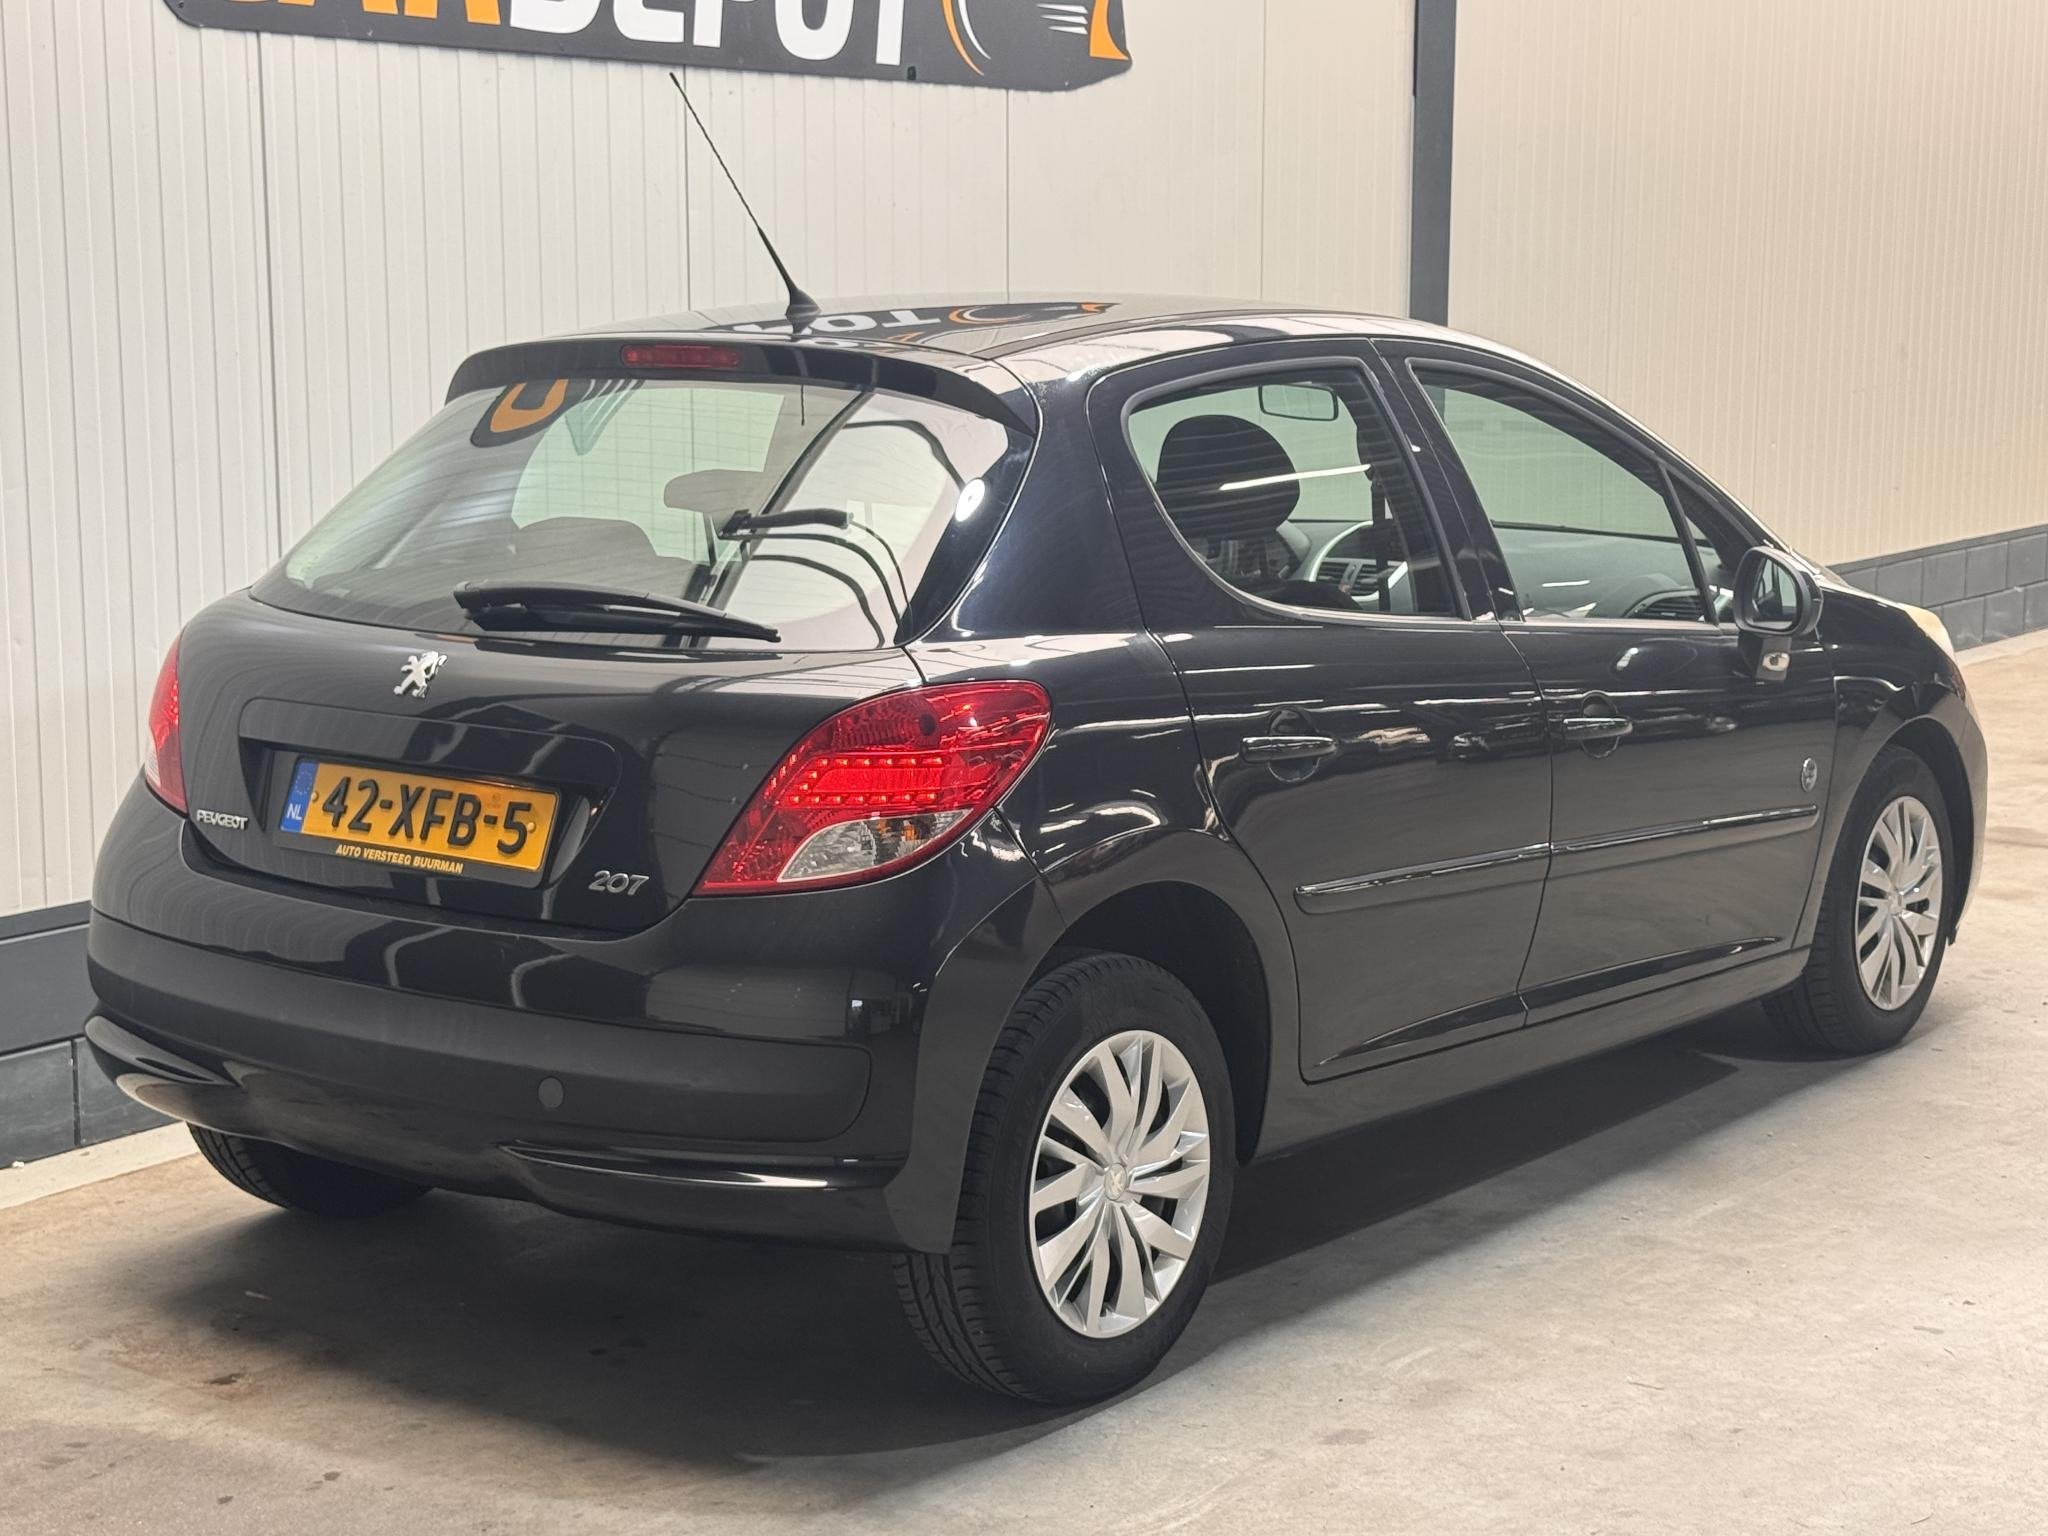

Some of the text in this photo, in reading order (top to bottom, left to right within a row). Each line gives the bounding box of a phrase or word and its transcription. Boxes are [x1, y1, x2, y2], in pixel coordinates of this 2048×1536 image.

[197, 809, 249, 830] PEUGEOT
[286, 803, 303, 820] NL
[322, 777, 532, 854] 42-XFB-5
[335, 844, 464, 874] AUTO VERSTEEG BUURMAN
[588, 870, 650, 895] 207
